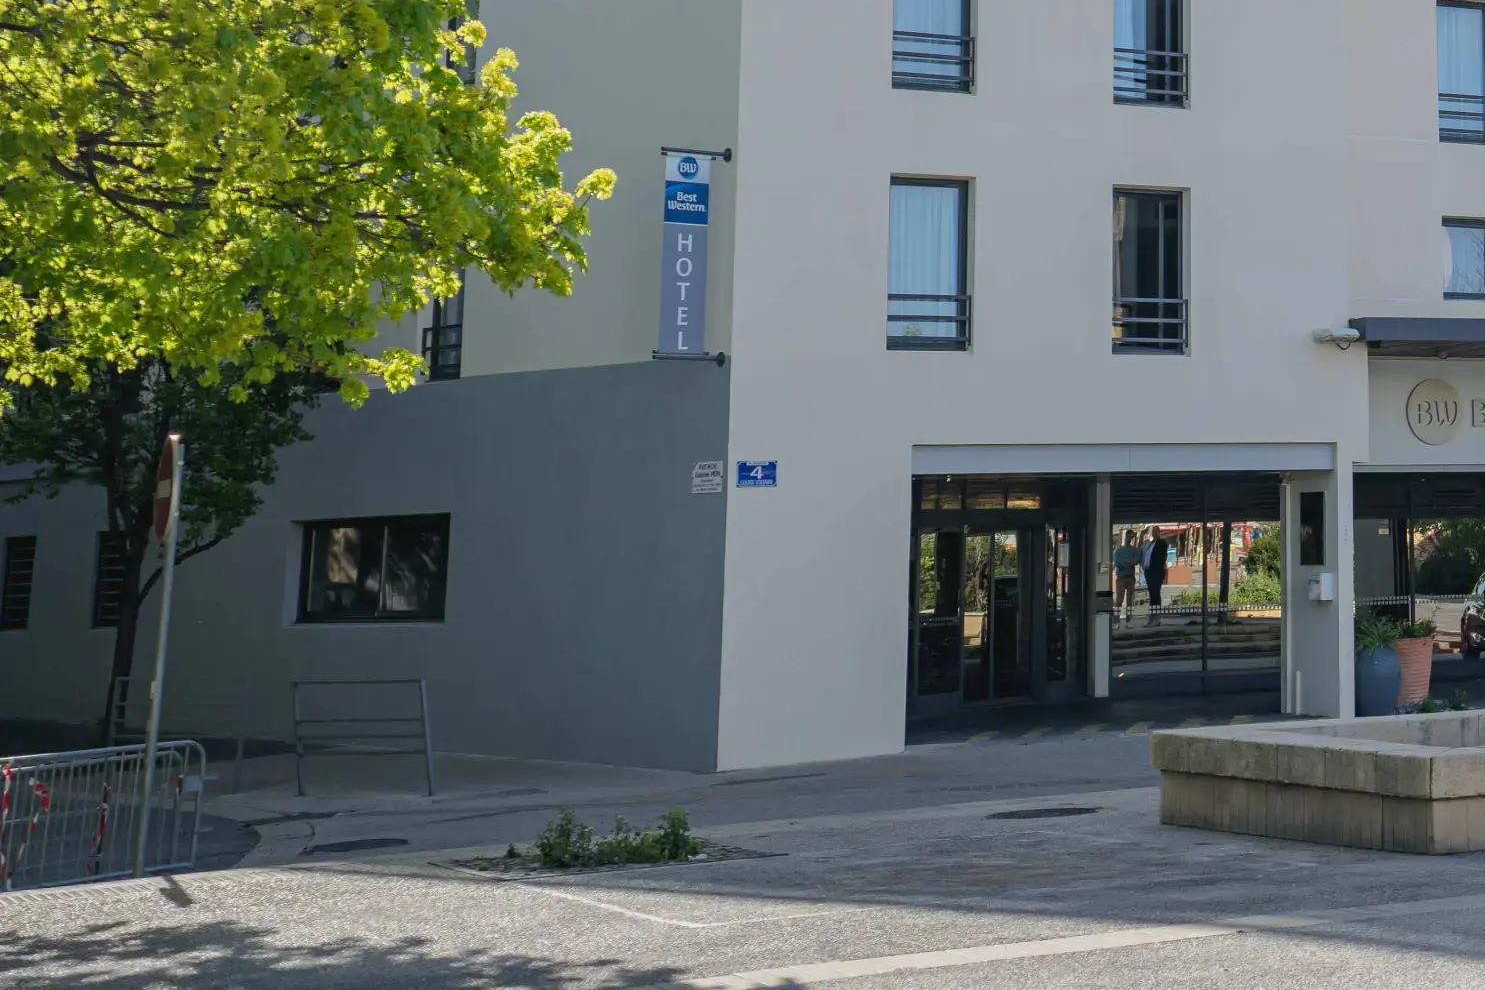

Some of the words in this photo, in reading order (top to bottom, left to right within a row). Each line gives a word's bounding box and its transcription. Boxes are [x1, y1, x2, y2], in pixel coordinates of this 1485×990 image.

[680, 162, 697, 173] BW
[676, 191, 697, 202] Best
[667, 200, 705, 212] Western
[676, 233, 693, 350] HOTEL
[1417, 400, 1458, 427] BW
[750, 466, 764, 479] 4
